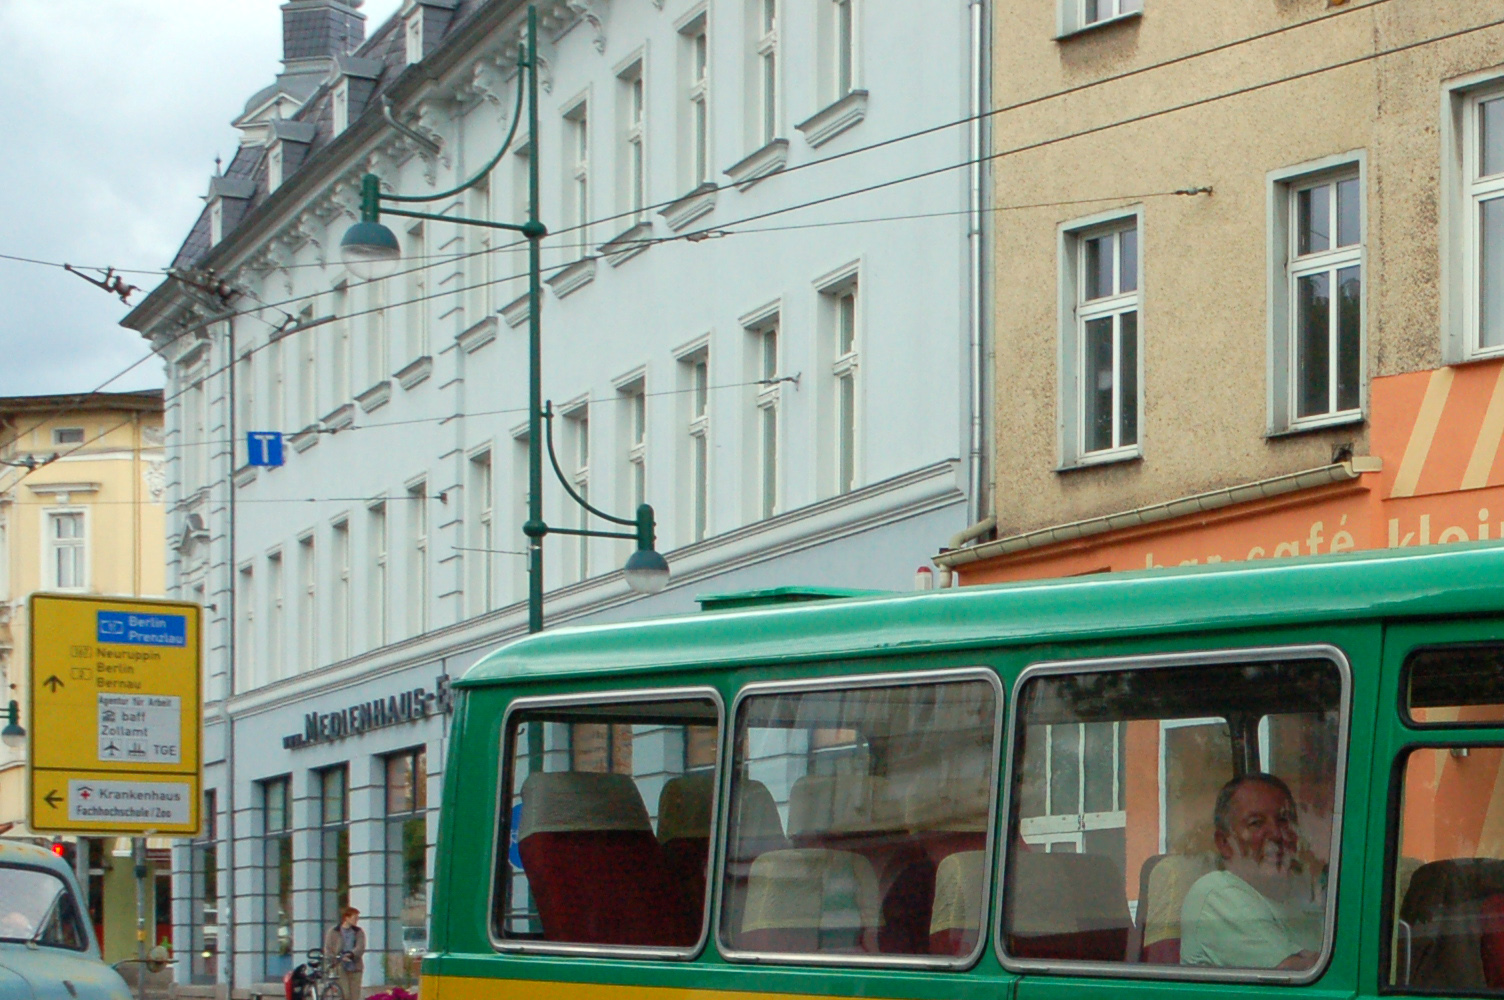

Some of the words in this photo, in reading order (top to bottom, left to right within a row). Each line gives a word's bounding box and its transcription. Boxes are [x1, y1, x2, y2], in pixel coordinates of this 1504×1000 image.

[254, 436, 275, 464] T
[128, 615, 167, 628] Berlin
[128, 630, 184, 644] Prenzlau
[96, 648, 161, 662] Neuruppin
[96, 662, 135, 674] Berlin
[96, 677, 142, 689] Bernau
[101, 725, 148, 737] Zollamt
[153, 744, 177, 756] TGE
[99, 788, 181, 801] Krankenhaus
